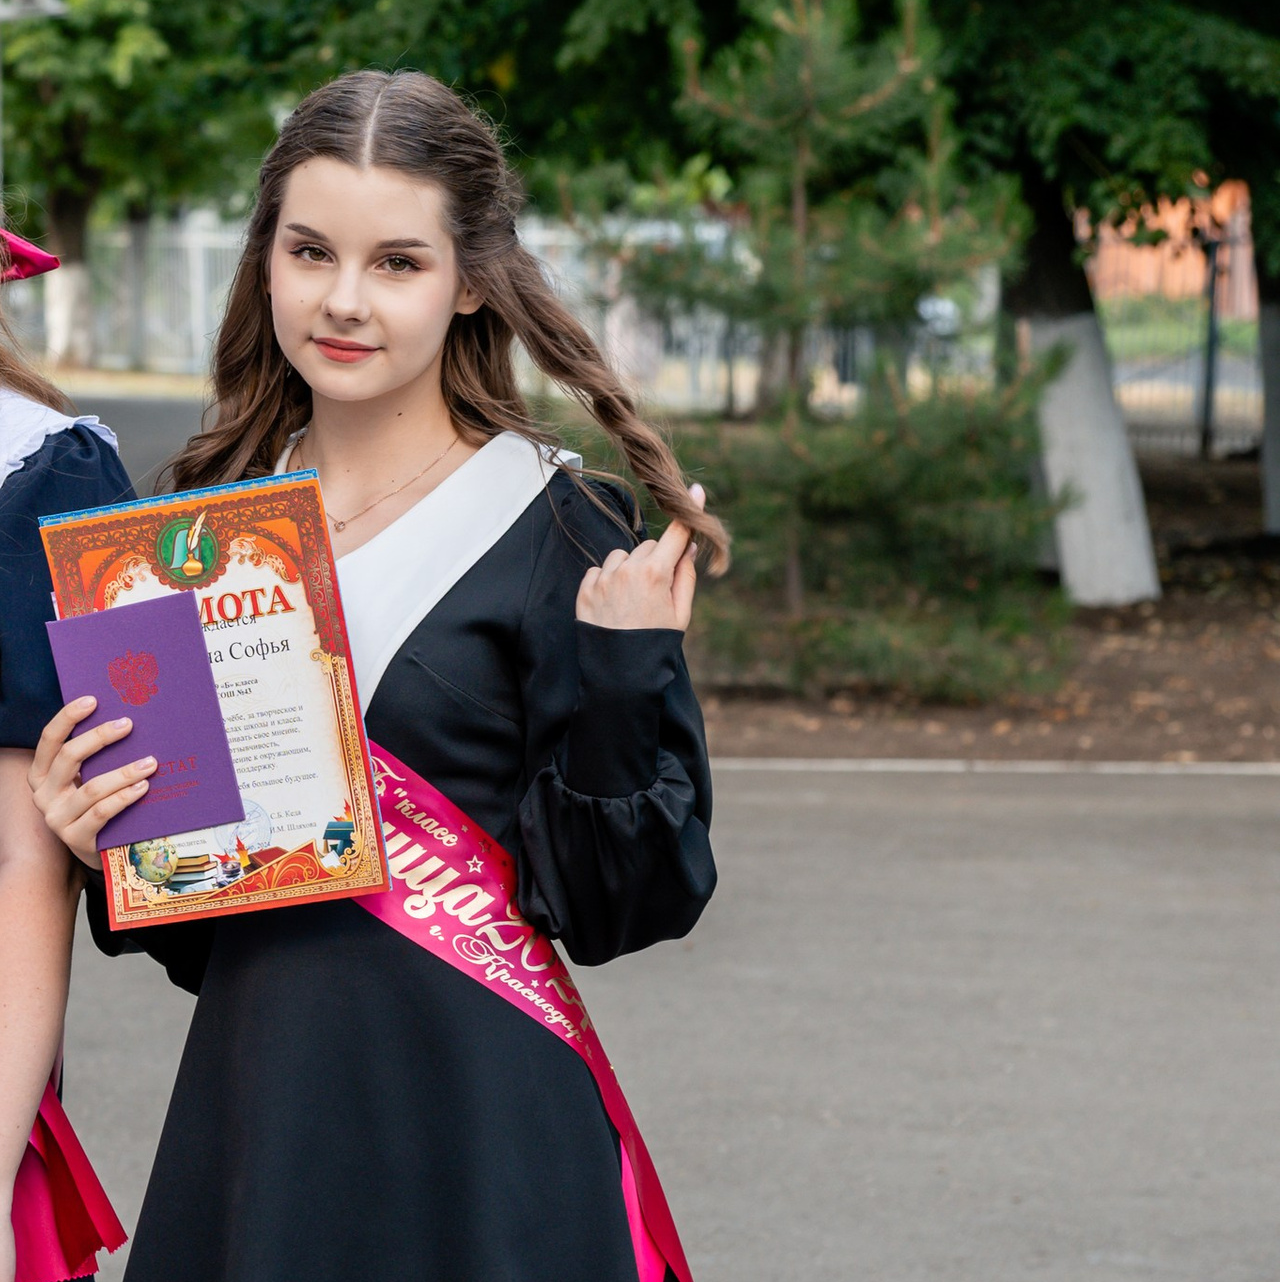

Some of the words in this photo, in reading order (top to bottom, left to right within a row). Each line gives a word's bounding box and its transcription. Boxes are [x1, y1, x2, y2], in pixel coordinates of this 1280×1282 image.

[200, 585, 296, 626] МОТА
[229, 638, 291, 660] Софья
[235, 678, 259, 688] класса
[256, 707, 297, 719] творческое
[252, 777, 283, 789] большое
[394, 798, 459, 847] класс
[452, 933, 583, 1043] Краснодар
